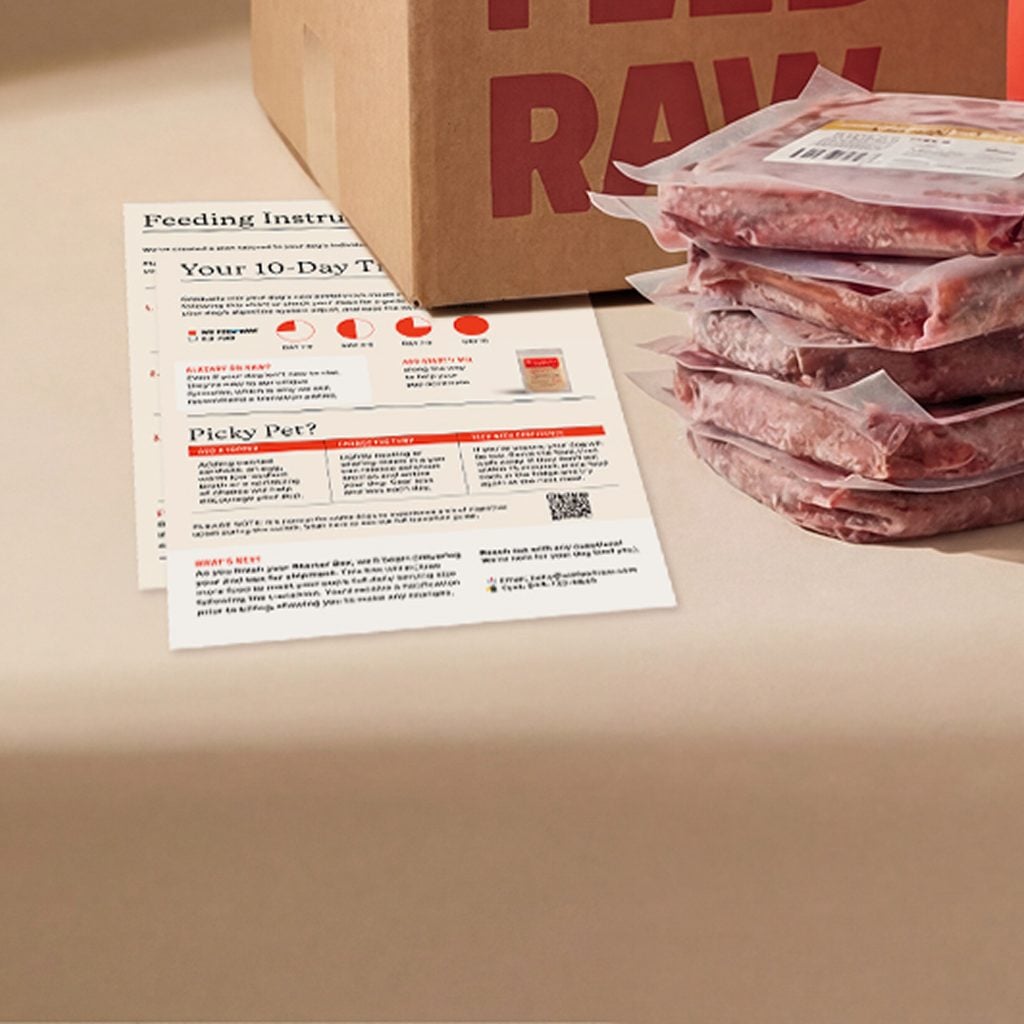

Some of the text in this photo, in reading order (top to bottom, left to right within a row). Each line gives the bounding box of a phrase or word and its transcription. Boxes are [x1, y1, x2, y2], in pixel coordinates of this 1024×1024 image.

[143, 212, 255, 230] Feeding
[181, 262, 247, 277] Your
[256, 259, 349, 276] 10-Day
[189, 422, 317, 442] Picky Pet?
